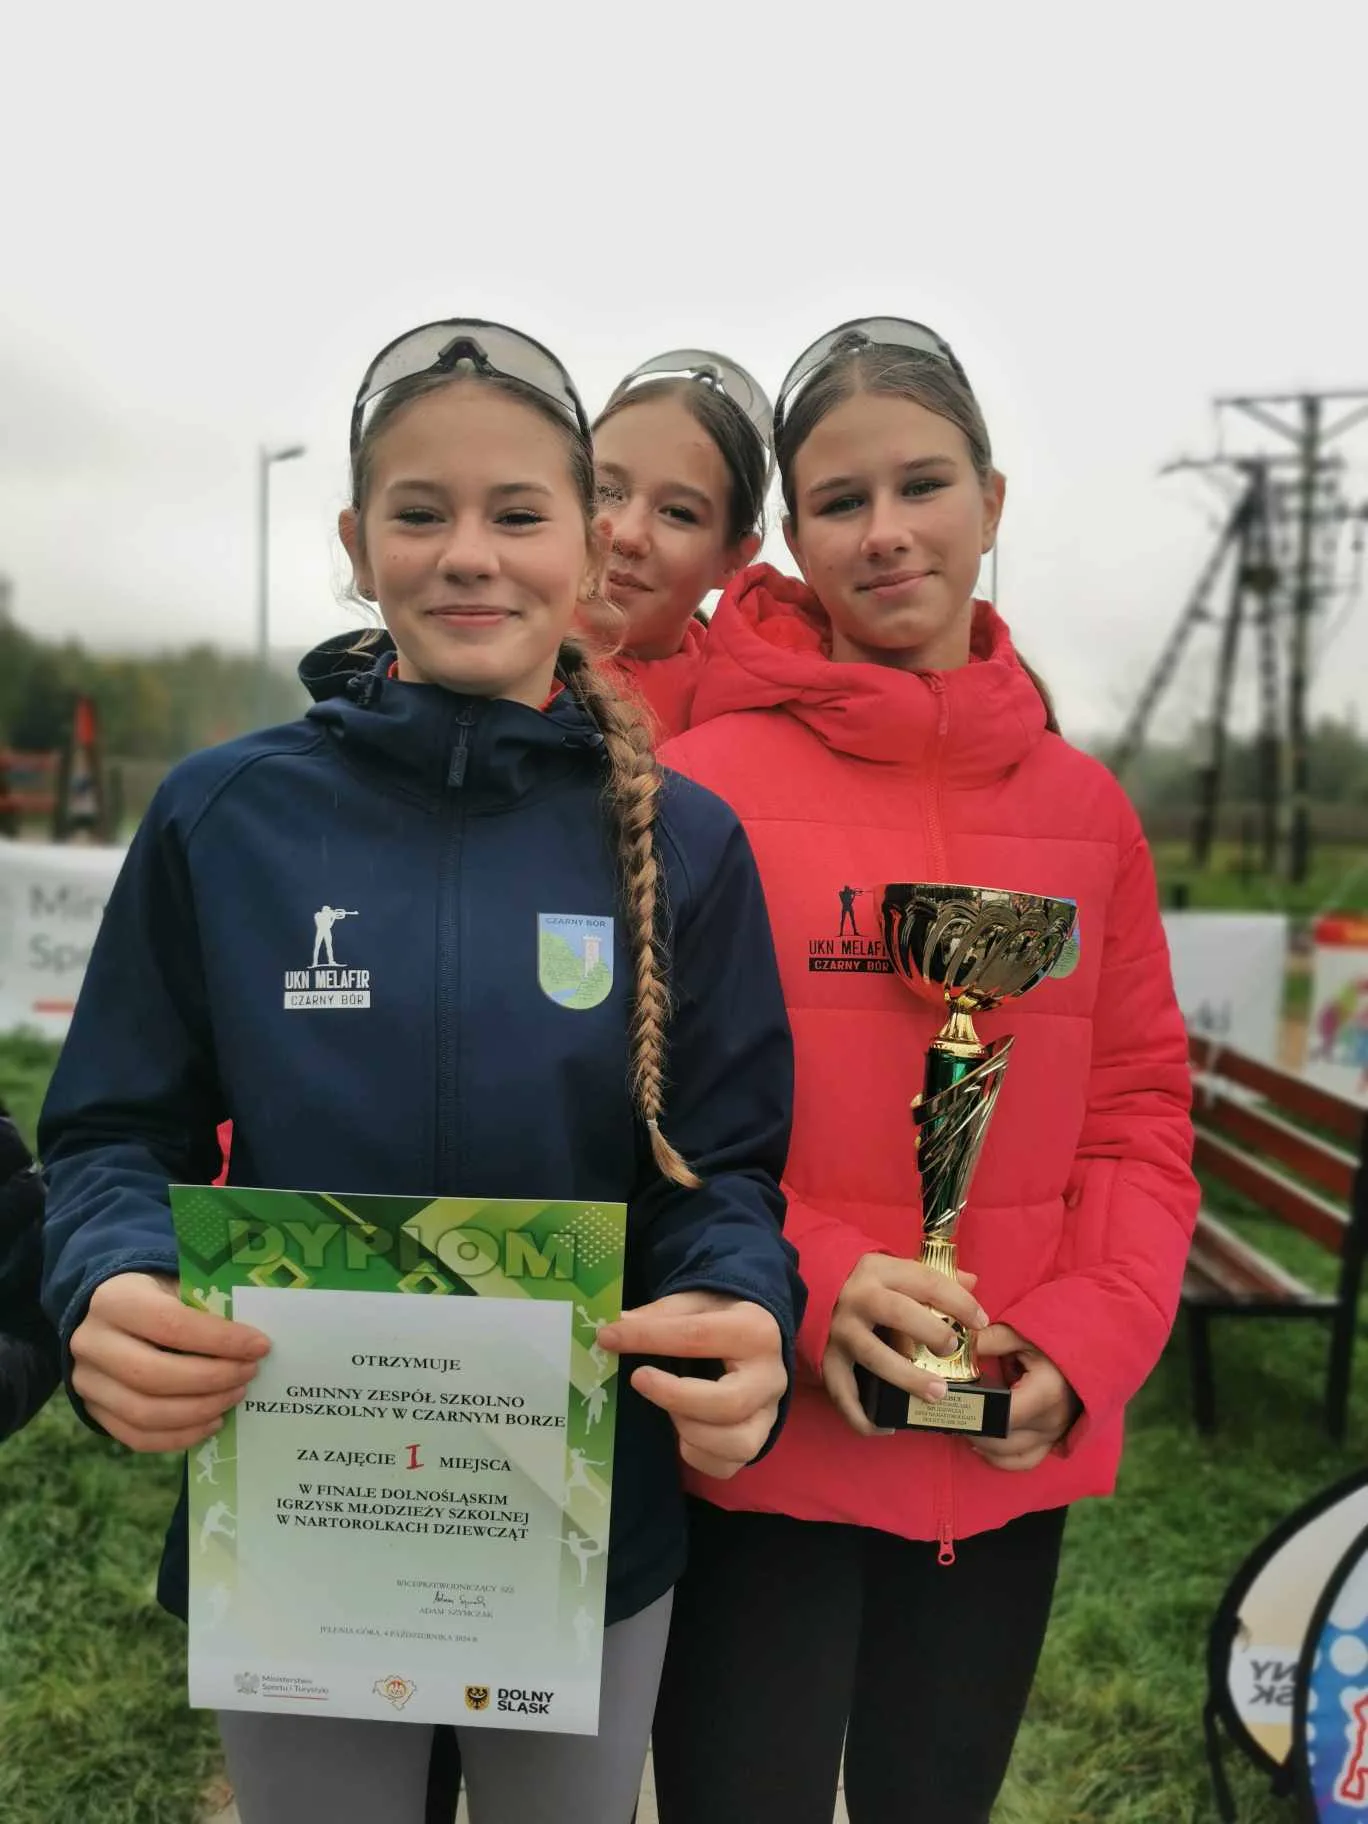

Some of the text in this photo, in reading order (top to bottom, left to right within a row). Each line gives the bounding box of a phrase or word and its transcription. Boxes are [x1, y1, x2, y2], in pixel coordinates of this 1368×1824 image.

[545, 917, 584, 926] CZARNY
[809, 940, 886, 957] UKN MELAFI
[814, 960, 860, 971] CZARNY
[285, 970, 370, 989] UKN MELAFIR
[290, 993, 364, 1006] CZARNY BÓR
[228, 1219, 577, 1280] DYPLOM
[352, 1354, 461, 1373] OTRZYMUJE
[286, 1386, 525, 1408] GMINNY ZESPÓŁ SZKOLNO
[245, 1401, 566, 1428] PRZEDSZKOLNY W CZARNYM BORZE
[297, 1449, 319, 1461] ZA
[324, 1450, 396, 1467] ZAJĘCIE
[439, 1456, 512, 1473] MIEJSCA
[299, 1483, 508, 1506] W FINALE DOLNOŚLĄSKIM
[277, 1498, 529, 1526] IGRZYSK MŁODZIEŻY SZKOLNEJ
[276, 1514, 529, 1541] W NARTOROLKACH DZIEWCZĄT
[498, 1688, 554, 1703] DOLNY
